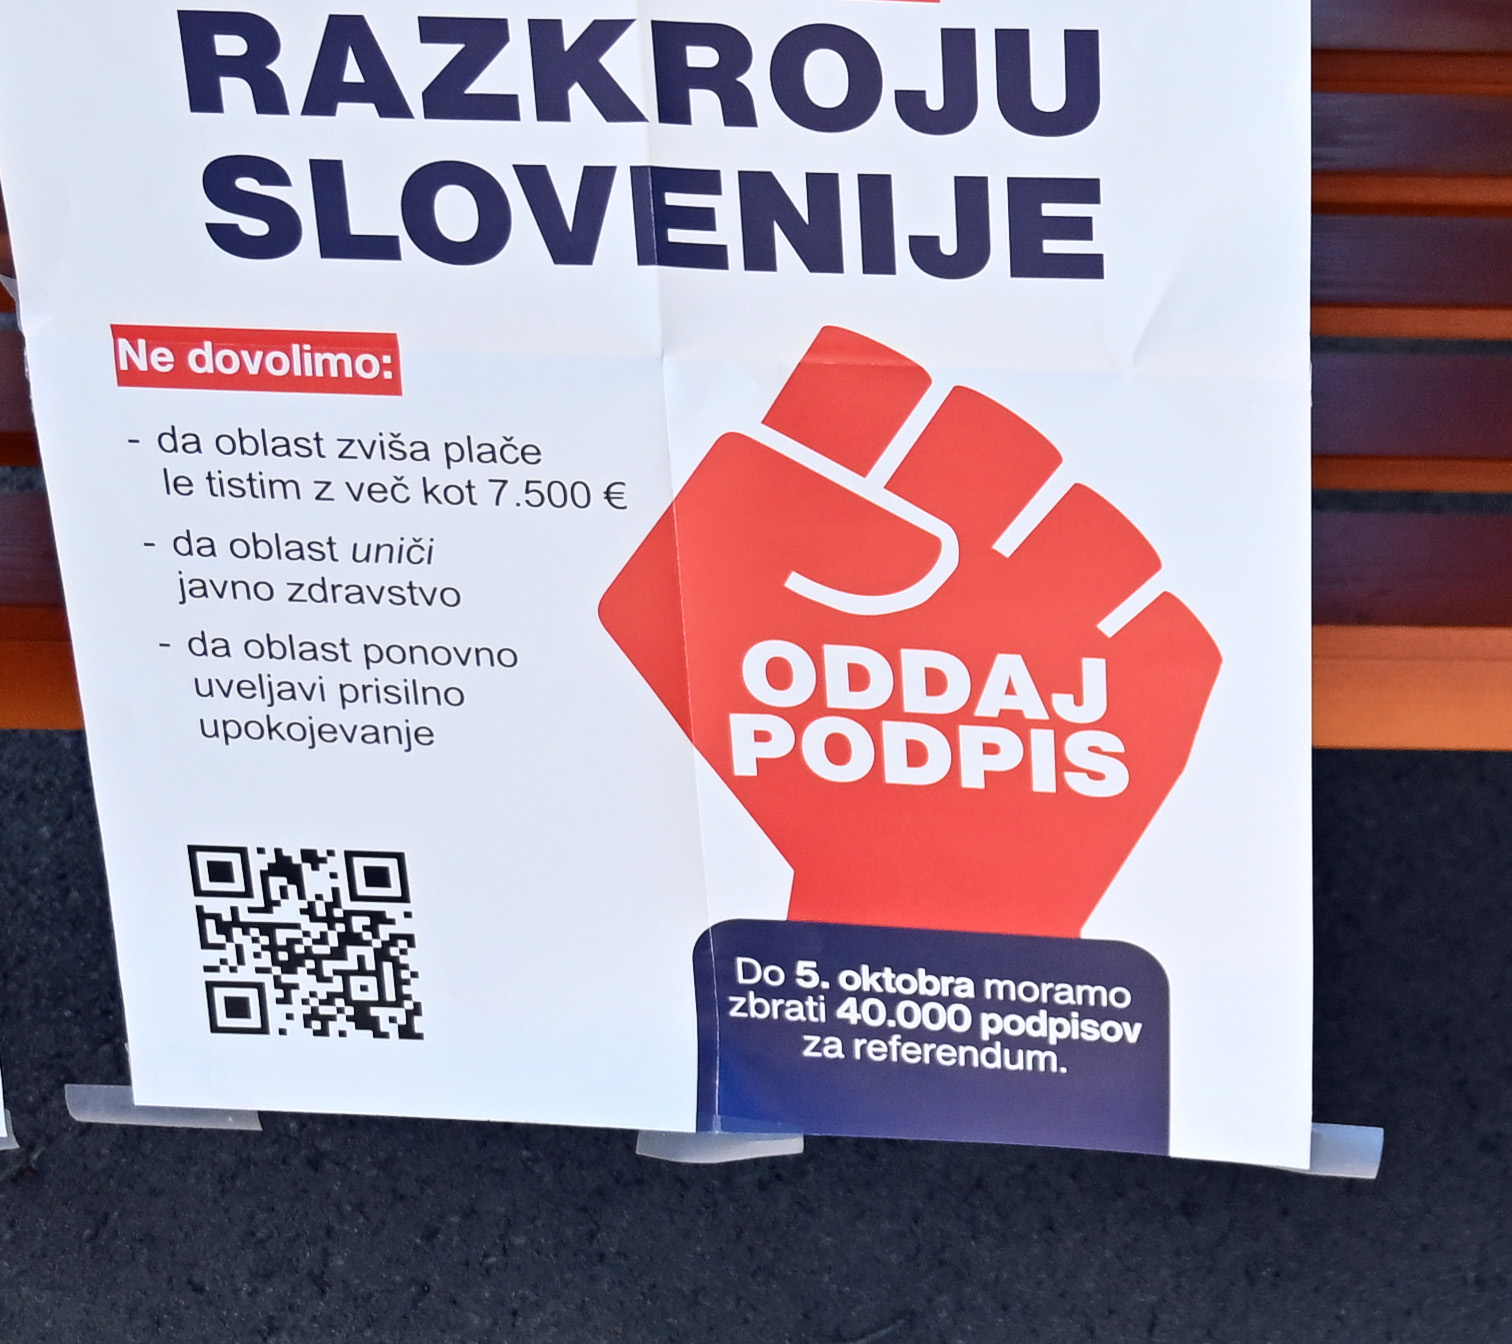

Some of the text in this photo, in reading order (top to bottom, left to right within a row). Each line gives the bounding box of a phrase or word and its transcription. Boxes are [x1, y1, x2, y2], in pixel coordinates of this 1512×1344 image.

[177, 10, 1100, 137] RAZKROJU
[203, 155, 1104, 279] SLOVENIJE
[118, 338, 392, 379] Ne dovolimo:
[158, 425, 541, 469] da oblast zviša plače
[164, 468, 627, 509] le tistim z več kot 7.500 €
[173, 529, 433, 564] da oblast uniči
[179, 571, 460, 607] javno zdravstvo
[188, 631, 517, 670] da oblast ponovno
[195, 673, 464, 709] uveljavi prisilno
[742, 640, 1107, 723] ODDAJ
[200, 715, 434, 752] upokojevanje
[730, 713, 1129, 797] PODPIS
[736, 957, 1131, 1008] Do 5. oktobra moramo
[729, 991, 1142, 1045] zbrati 40.000 podpisov
[803, 1034, 1067, 1073] za referendum.
